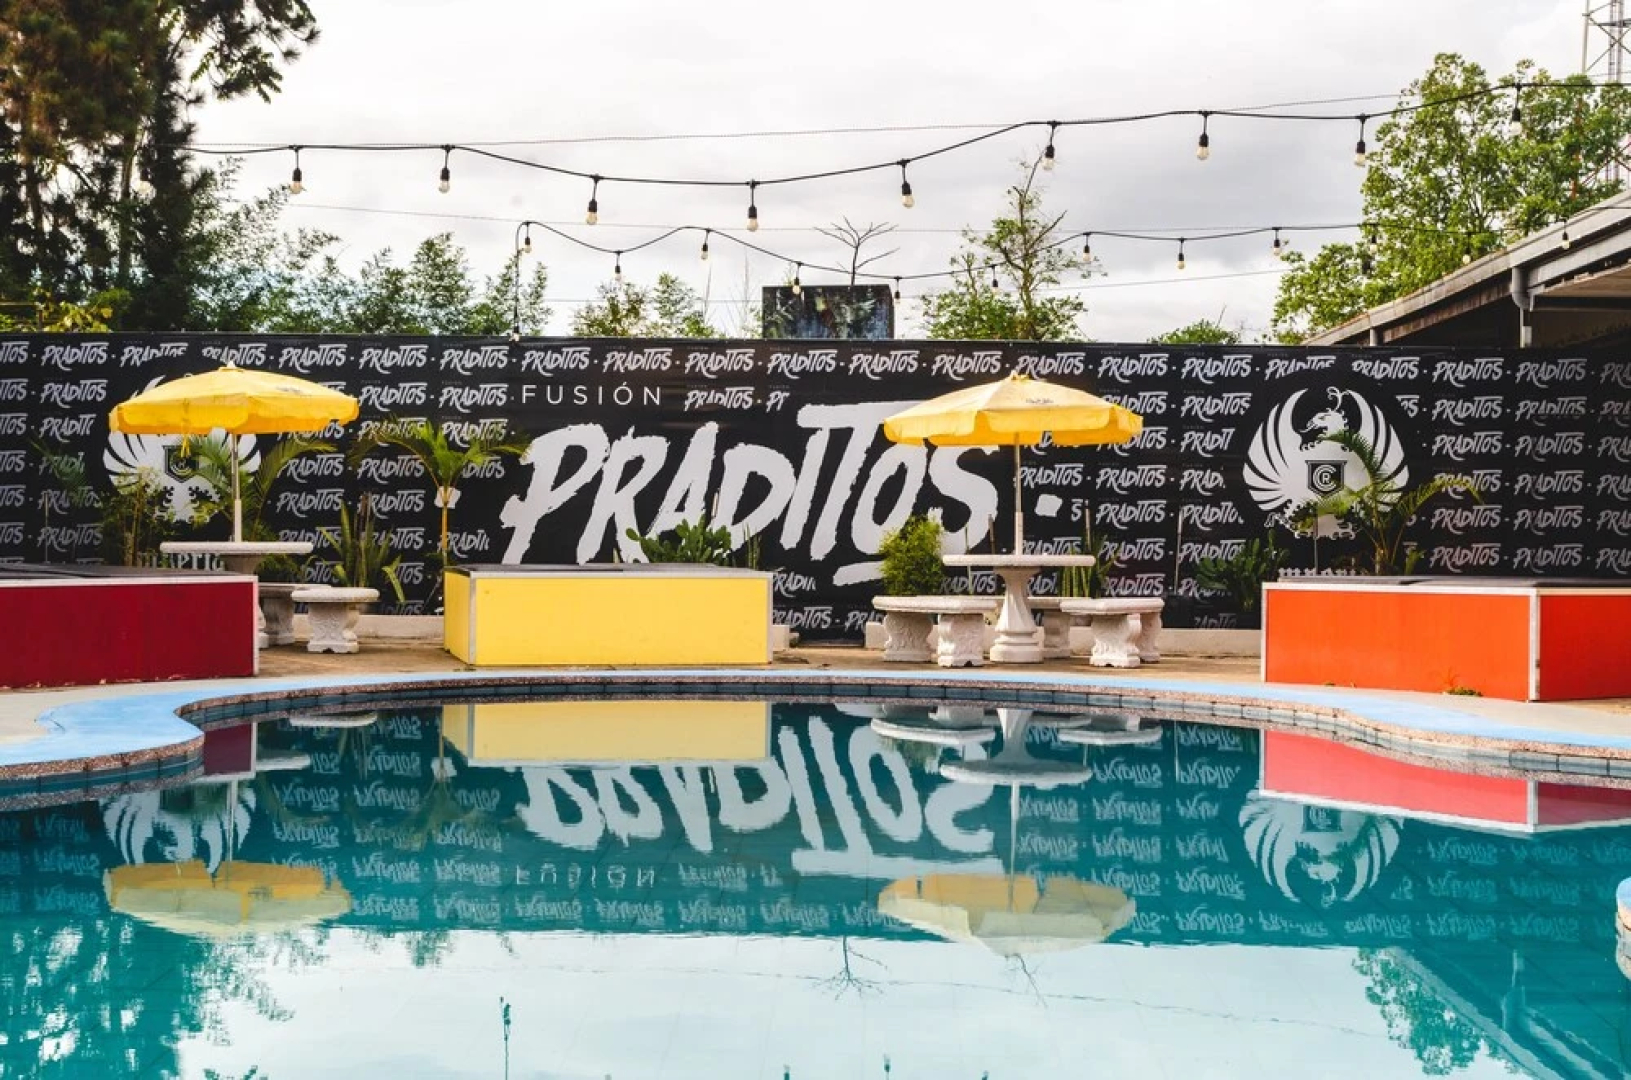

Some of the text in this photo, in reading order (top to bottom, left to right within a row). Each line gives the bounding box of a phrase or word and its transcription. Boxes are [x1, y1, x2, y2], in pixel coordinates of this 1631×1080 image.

[41, 342, 109, 371] PRADITOS
[278, 343, 347, 373] PRADITOS
[359, 345, 429, 374] PRADITOS
[439, 345, 509, 375] PRADITOS
[521, 347, 591, 376] PRADITOS
[603, 348, 673, 373] PRADITOS
[685, 349, 755, 379] PRADITOS
[767, 349, 837, 379] PRADITOS
[848, 350, 919, 380] PRADITOS
[931, 351, 1003, 381] PRADITOS
[1015, 352, 1086, 379] PRADITOS
[1098, 353, 1169, 383] PRADITOS
[1181, 354, 1253, 384] PRADITOS
[1431, 358, 1504, 388] PRADITOS
[1515, 358, 1588, 388] PRADITOS
[40, 379, 109, 409] PRADITOS
[359, 382, 428, 411] PRADITOS
[440, 383, 509, 413] PRADITOS
[521, 381, 661, 406] FUSIÓN
[683, 386, 755, 412] PRADITOS
[1431, 396, 1504, 426] PRADITOS
[1180, 428, 1235, 458] PRADIT
[1431, 432, 1504, 462] PRADITOS
[1514, 432, 1585, 462] PRADITOS
[357, 454, 425, 485] PRADITOS
[1096, 464, 1167, 495] PRADITOS
[277, 488, 344, 518] PRADITOS
[499, 400, 1000, 586] PRADITOS
[1096, 500, 1166, 530] PRADITOS
[1431, 505, 1503, 535] PRADITOS
[1430, 543, 1502, 574] PRADITOS
